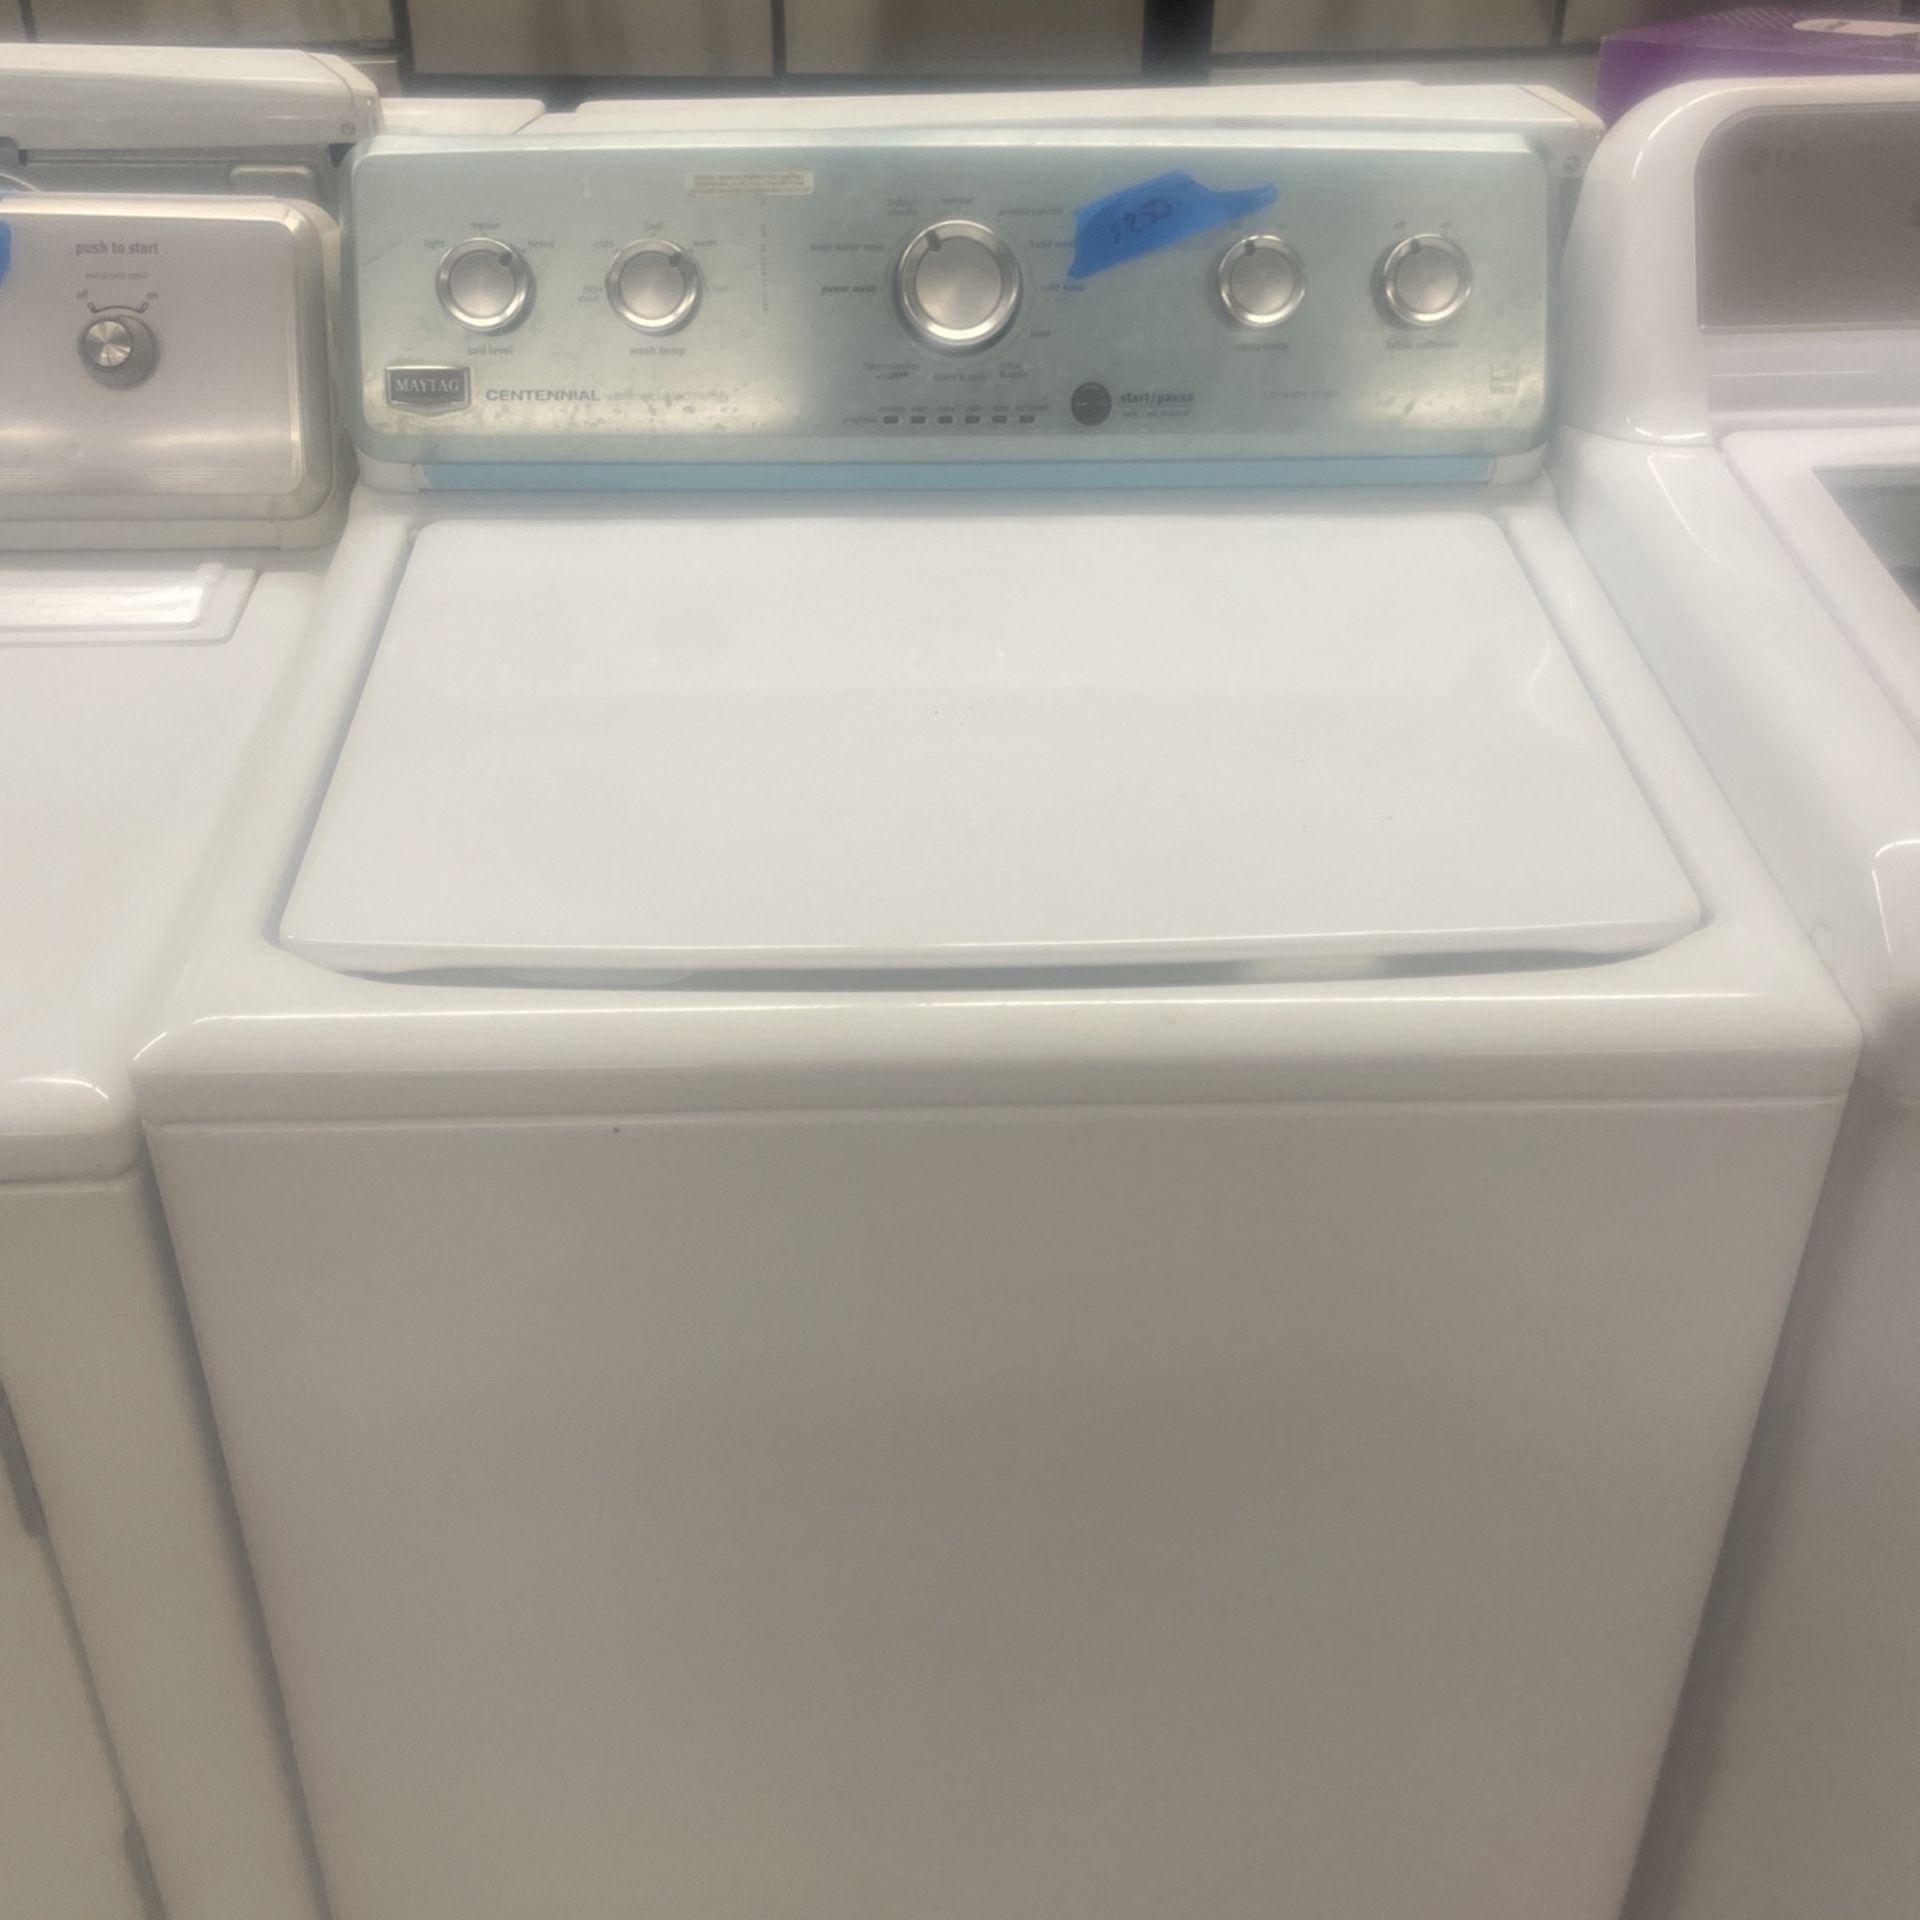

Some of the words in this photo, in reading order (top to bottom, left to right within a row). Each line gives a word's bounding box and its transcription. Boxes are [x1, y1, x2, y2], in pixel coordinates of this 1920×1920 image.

[75, 241, 108, 256] push
[112, 243, 125, 254] to
[128, 242, 159, 255] start
[395, 379, 460, 392] MAYTAG
[486, 388, 599, 401] CENTENNIAL
